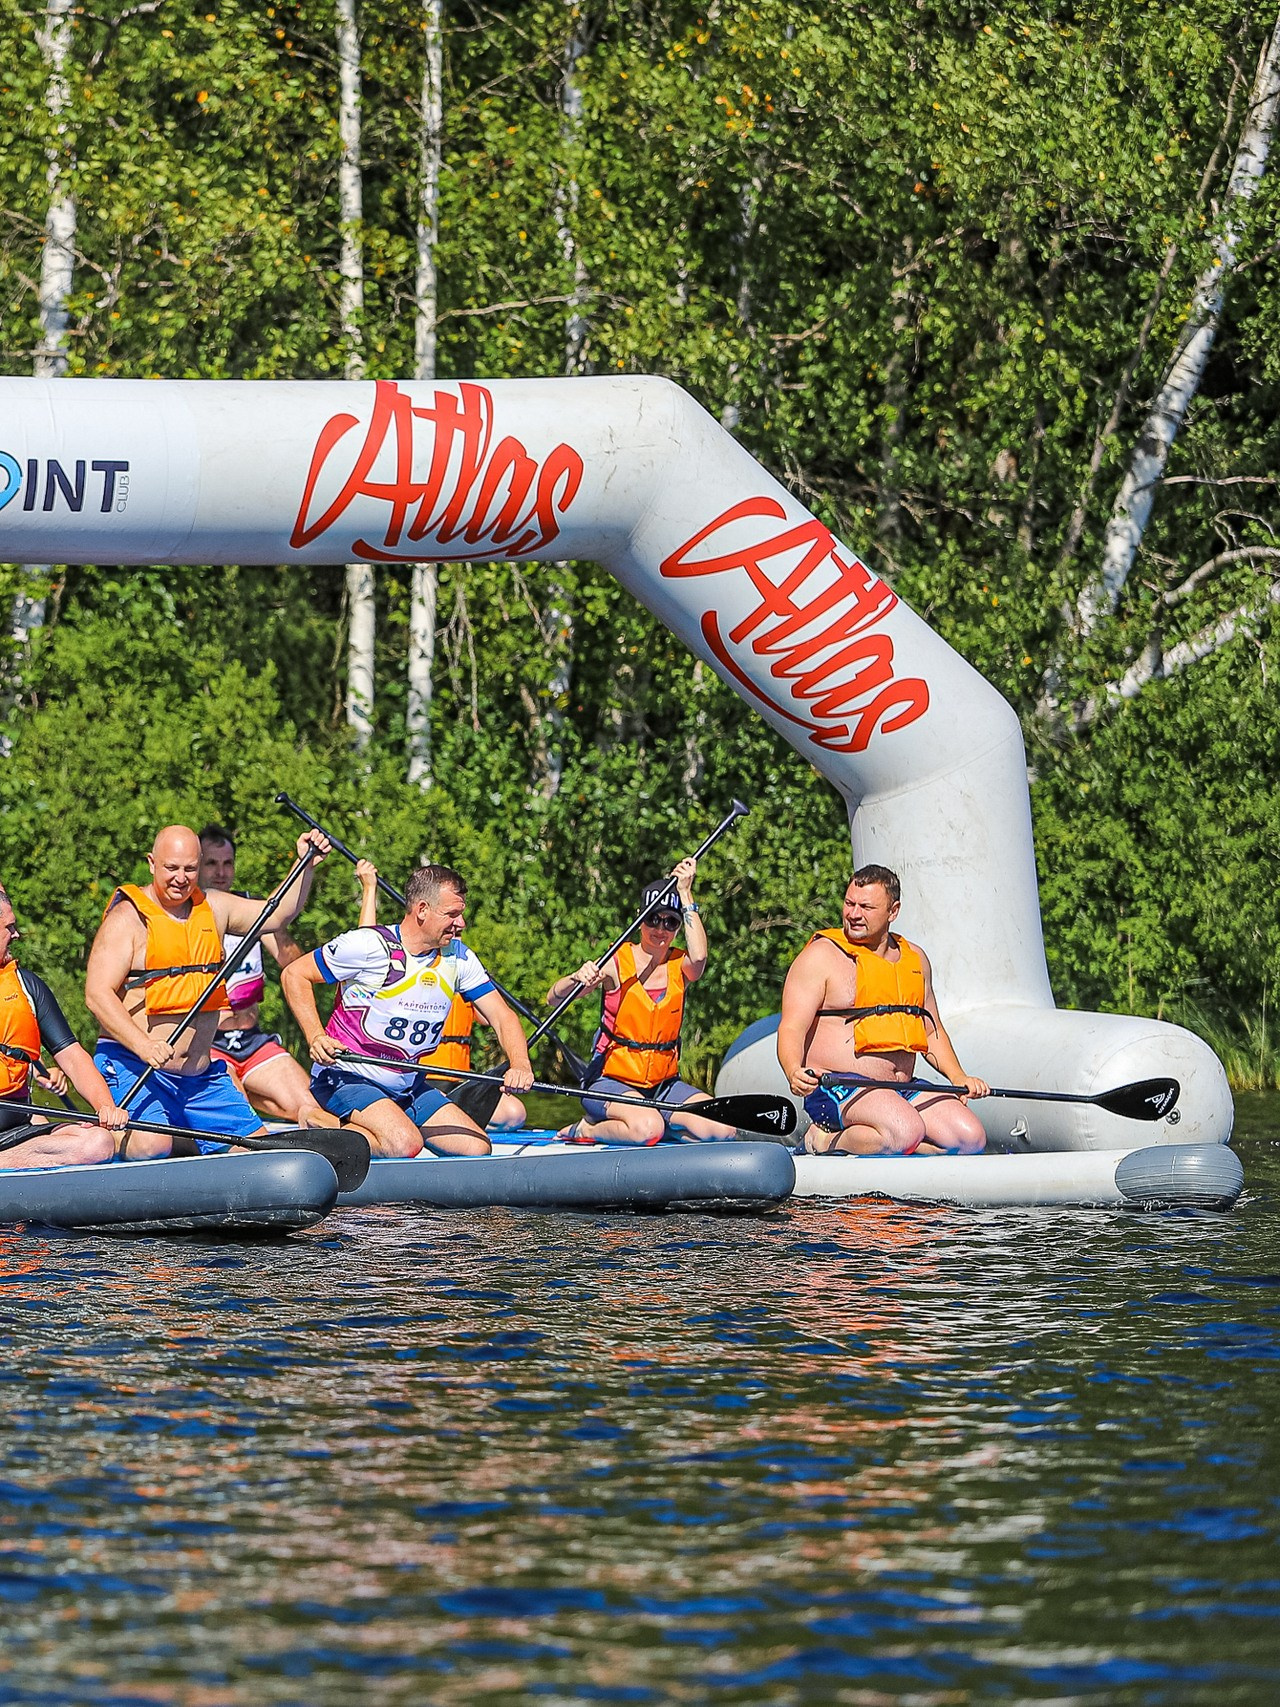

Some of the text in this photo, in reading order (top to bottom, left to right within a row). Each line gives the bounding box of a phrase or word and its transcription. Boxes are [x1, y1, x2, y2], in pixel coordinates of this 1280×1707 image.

[117, 475, 130, 513] CLUB
[289, 381, 584, 562] Atlas
[660, 496, 930, 753] Atlas
[384, 1016, 444, 1046] 889
